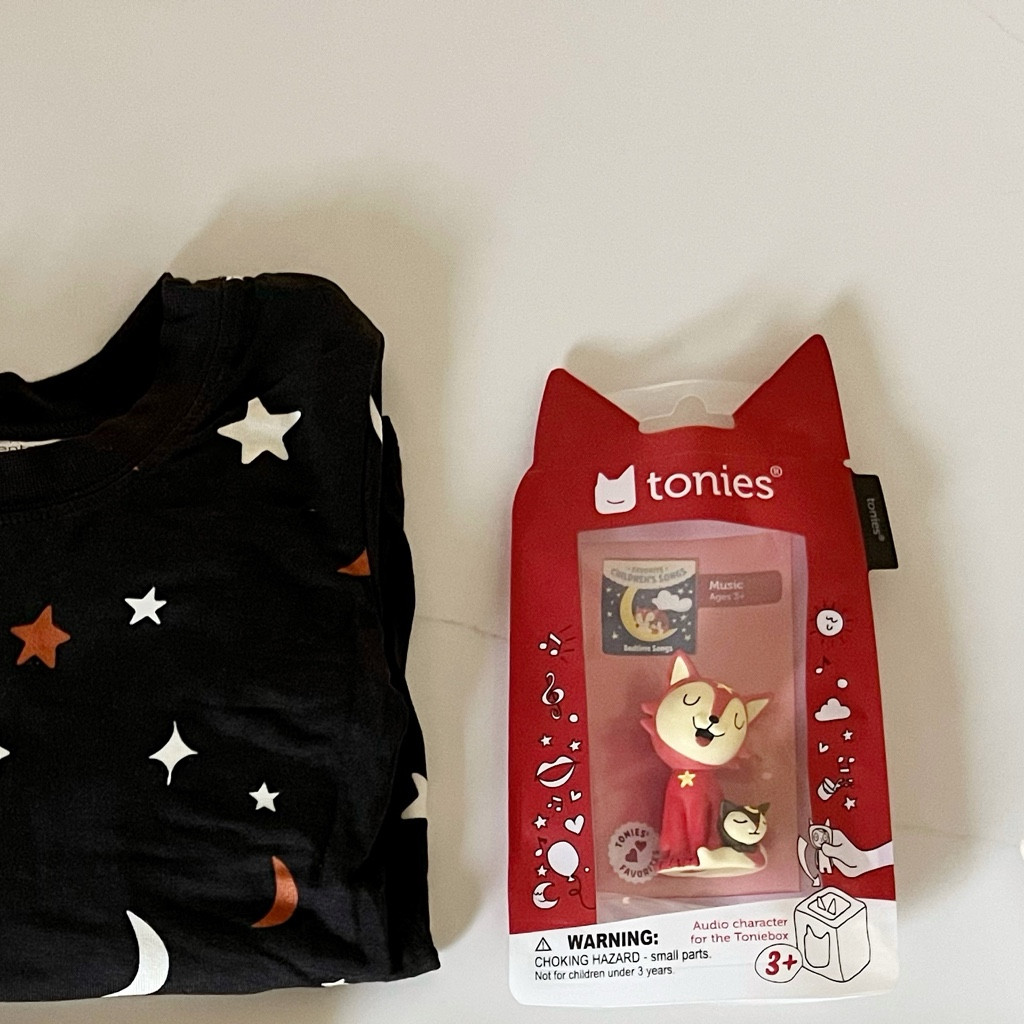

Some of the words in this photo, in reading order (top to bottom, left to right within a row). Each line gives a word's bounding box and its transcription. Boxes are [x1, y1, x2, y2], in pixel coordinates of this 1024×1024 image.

[709, 580, 744, 591] Music
[652, 644, 673, 654] Songs
[693, 920, 728, 932] Audio
[732, 917, 788, 929] character
[567, 929, 659, 951] WARNING:
[690, 933, 708, 944] for
[710, 932, 731, 943] the
[733, 930, 789, 942] Toniebox
[534, 954, 589, 968] CHOKING
[592, 951, 641, 966] HAZARD
[650, 949, 679, 962] small
[681, 949, 712, 963] parts.
[765, 950, 798, 976] 3+
[534, 970, 553, 981] Not
[553, 970, 566, 981] for
[568, 968, 605, 980] children
[607, 967, 635, 979] under
[637, 966, 644, 976] 3
